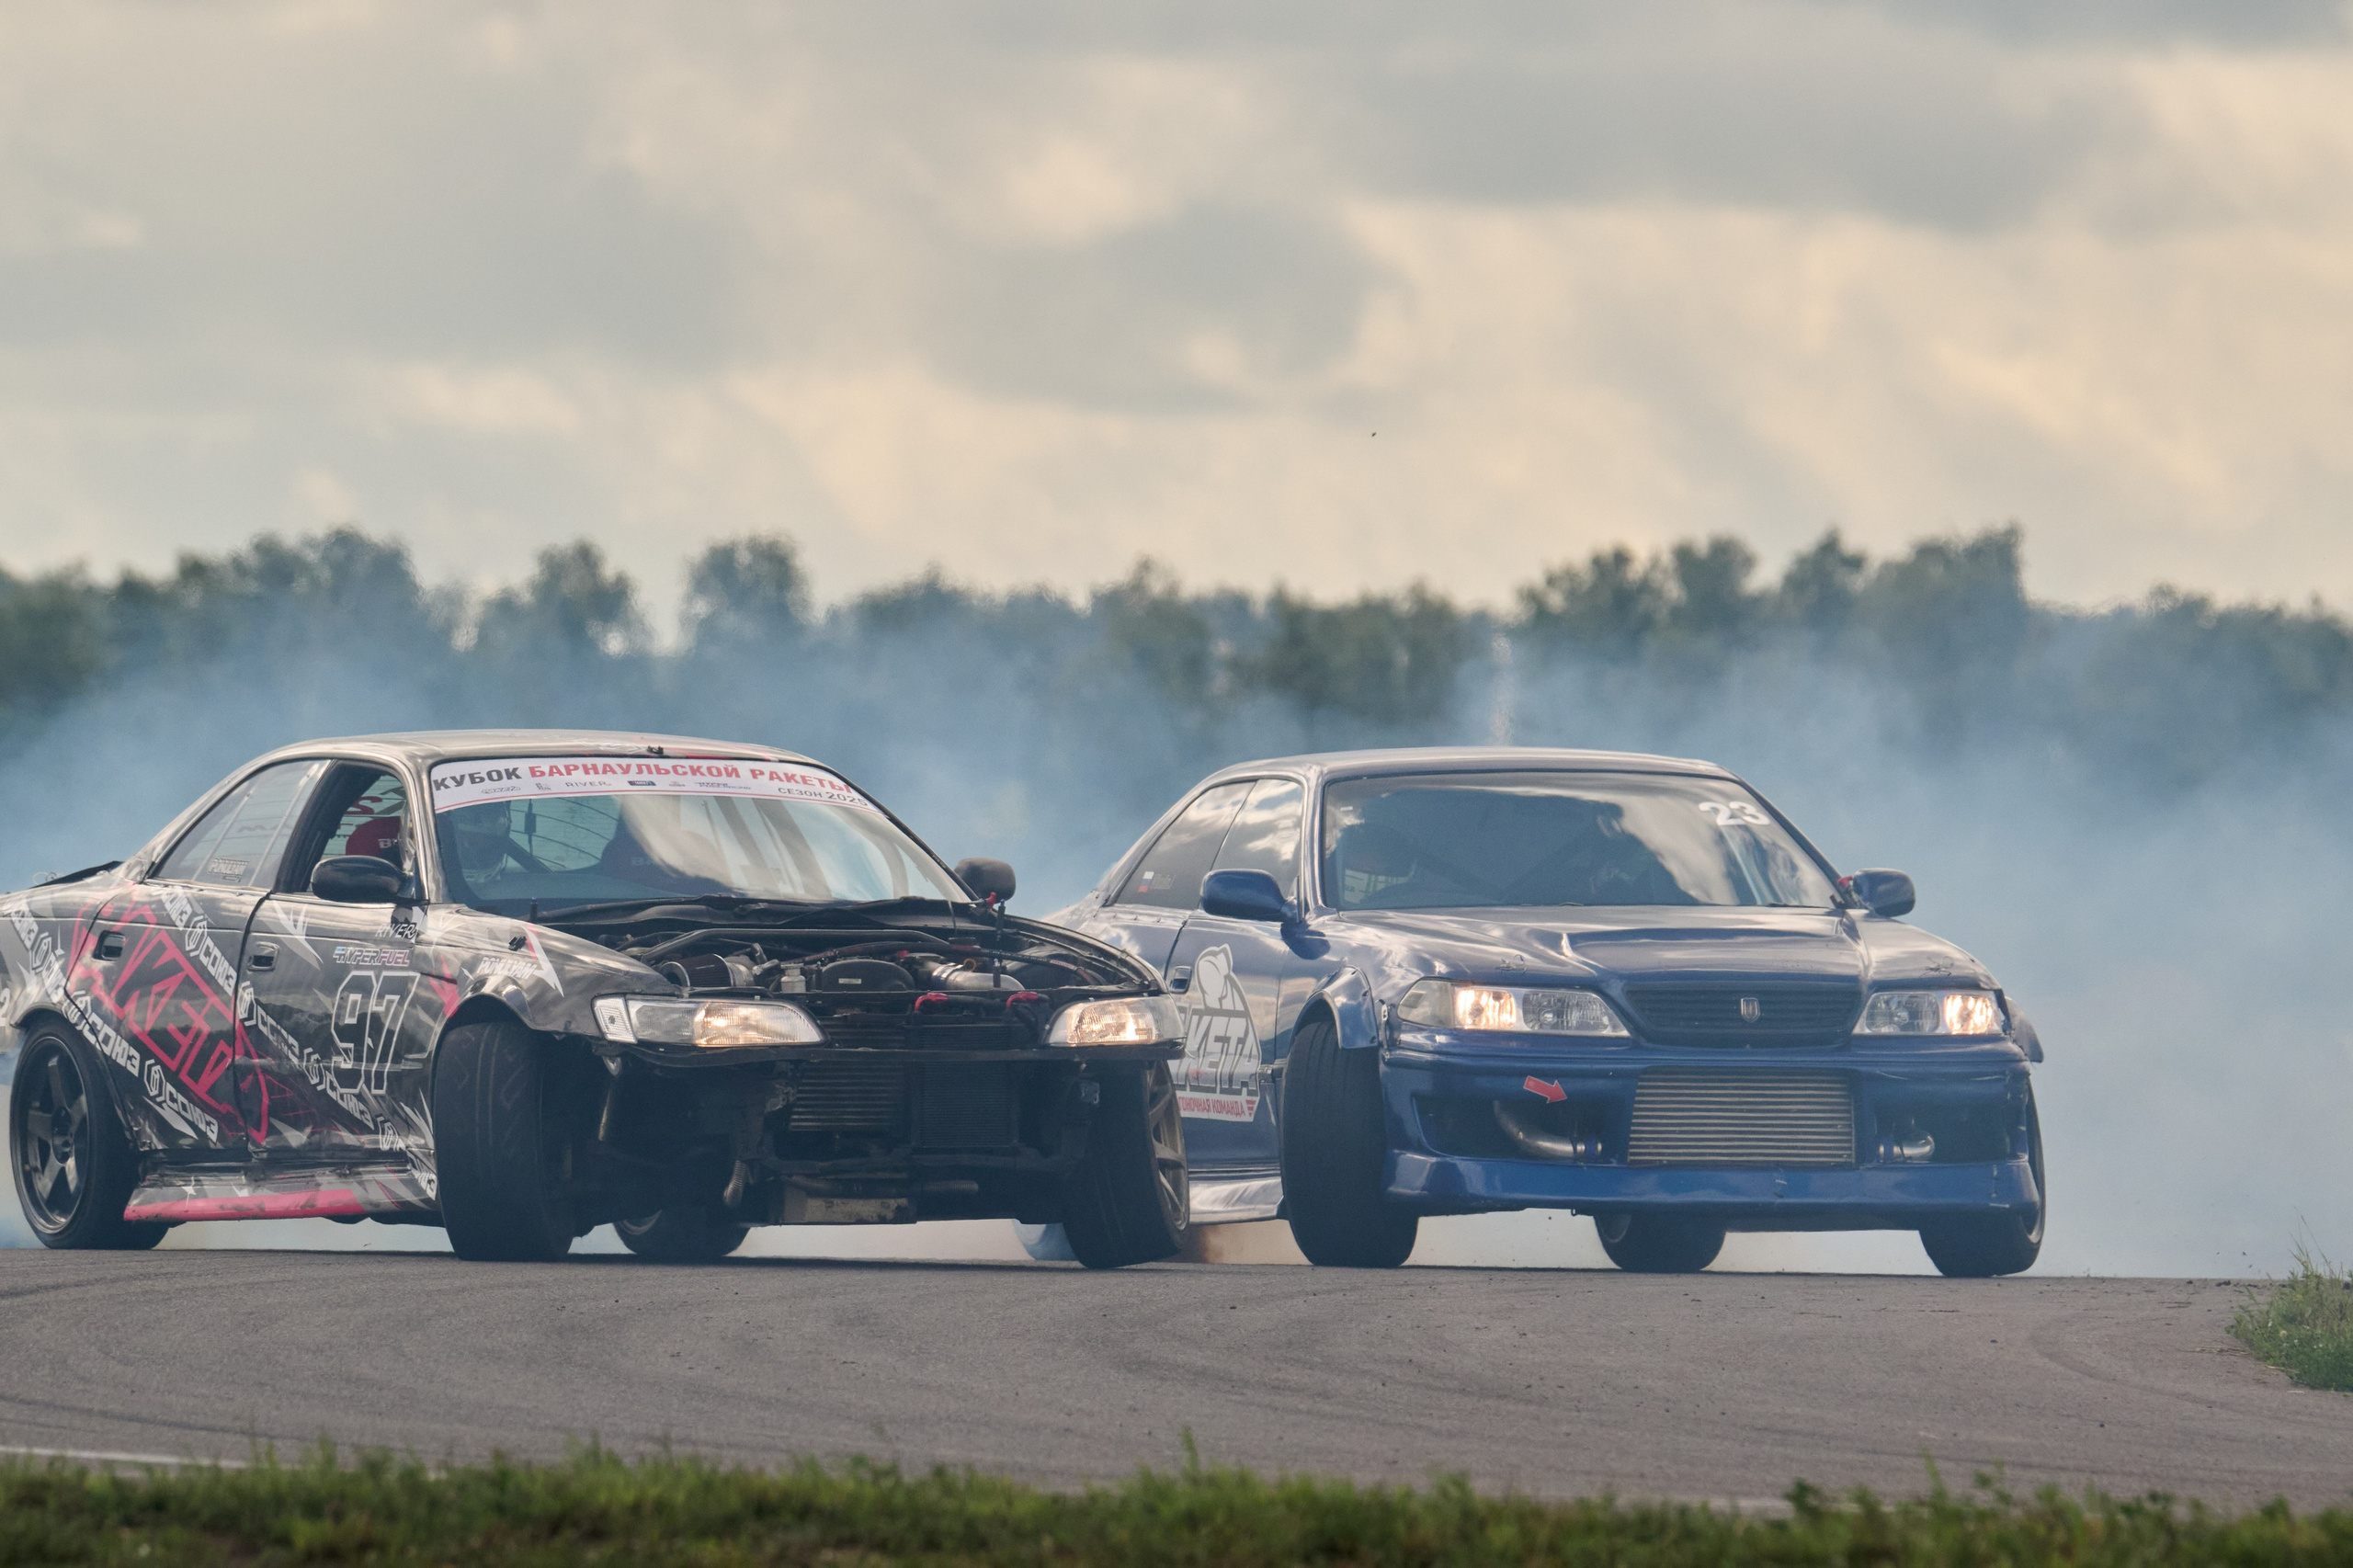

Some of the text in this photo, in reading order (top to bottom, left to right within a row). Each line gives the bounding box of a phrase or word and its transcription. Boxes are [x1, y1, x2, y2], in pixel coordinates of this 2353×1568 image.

[434, 763, 853, 793] КУБОК БАРНАУЛЬСКОЙ РАКЕТЫ
[778, 787, 869, 807] СЕЗОН 2025
[1698, 801, 1771, 825] 23
[199, 936, 238, 997] СОЮЗ
[83, 1012, 140, 1077] СОЮЗ
[332, 971, 421, 1094] 97
[165, 1082, 219, 1143] СОЮЗ
[1212, 1098, 1246, 1118] КОМАНДА
